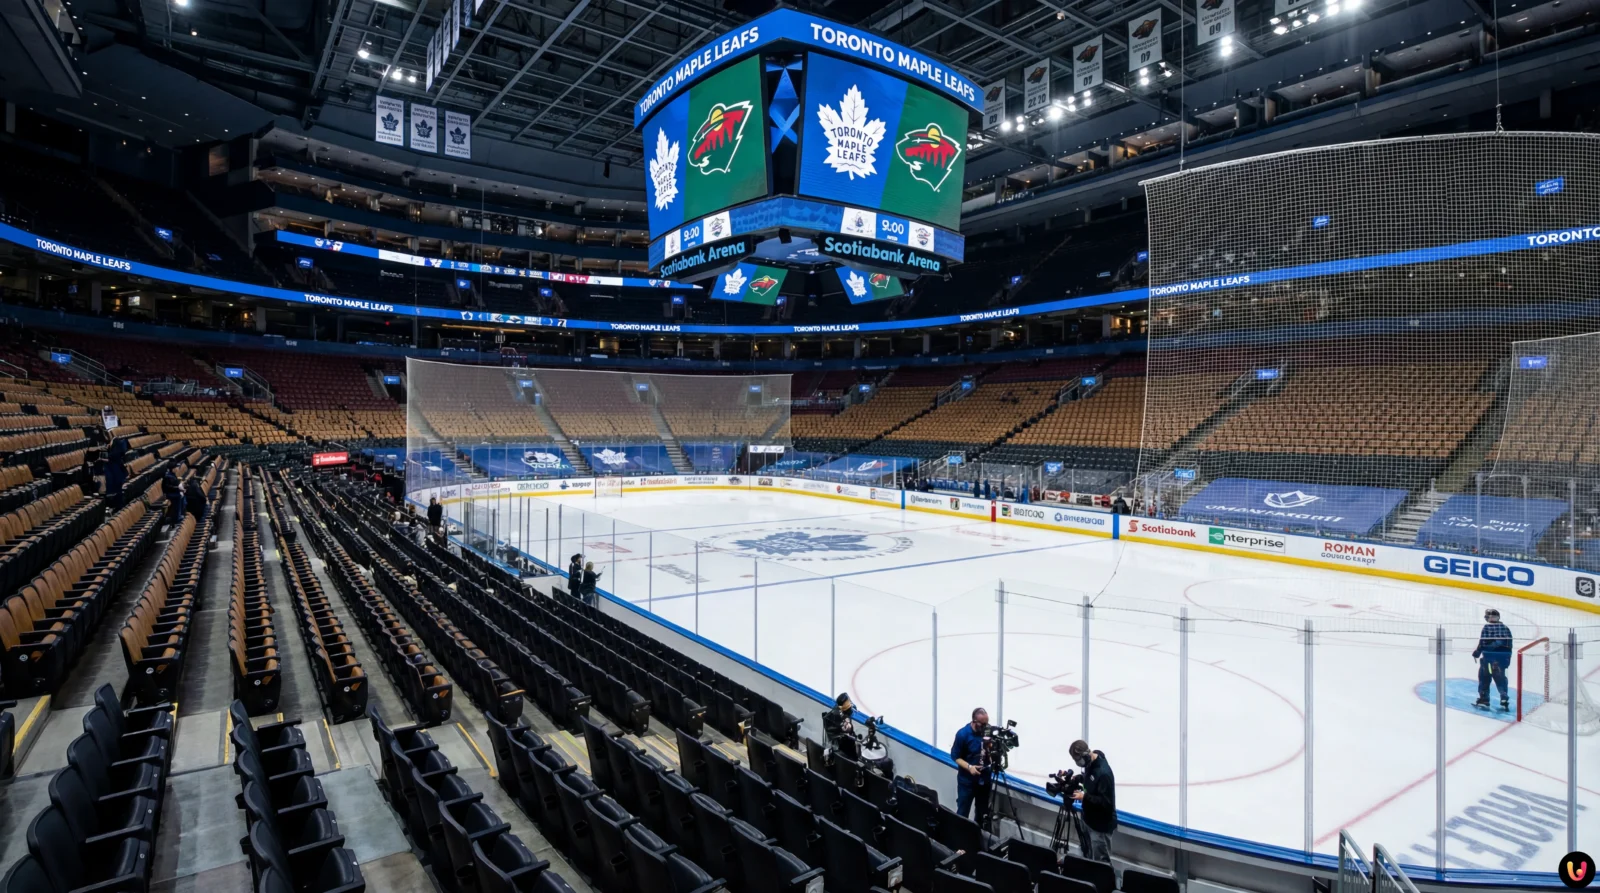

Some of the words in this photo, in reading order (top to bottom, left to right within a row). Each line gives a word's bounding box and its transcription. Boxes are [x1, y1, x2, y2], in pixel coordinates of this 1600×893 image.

[640, 76, 673, 116] TORONTO
[675, 49, 711, 86] MAPLE
[714, 26, 759, 61] LEAFS
[810, 23, 894, 62] TORONTO
[898, 51, 942, 83] MAPLE
[944, 73, 974, 101] LEAFS
[830, 126, 874, 147] TORONTO
[838, 139, 867, 153] MAPLE
[837, 149, 866, 163] LEAFS
[36, 238, 72, 257] TORONTO
[73, 250, 101, 264] MAPLE
[102, 258, 130, 271] LEAFS
[660, 249, 706, 278] Scotiabank
[708, 241, 745, 261] Arena
[824, 237, 904, 263] Scotiabank
[907, 252, 940, 271] Arena
[1151, 284, 1189, 296] TORONTO
[1190, 279, 1219, 290] MAPLE
[1221, 275, 1250, 287] LEAFS
[304, 294, 342, 305] TORONTO
[1142, 523, 1196, 538] Scotiabank
[1324, 542, 1375, 557] ROMAN
[1423, 555, 1535, 587] GEICO
